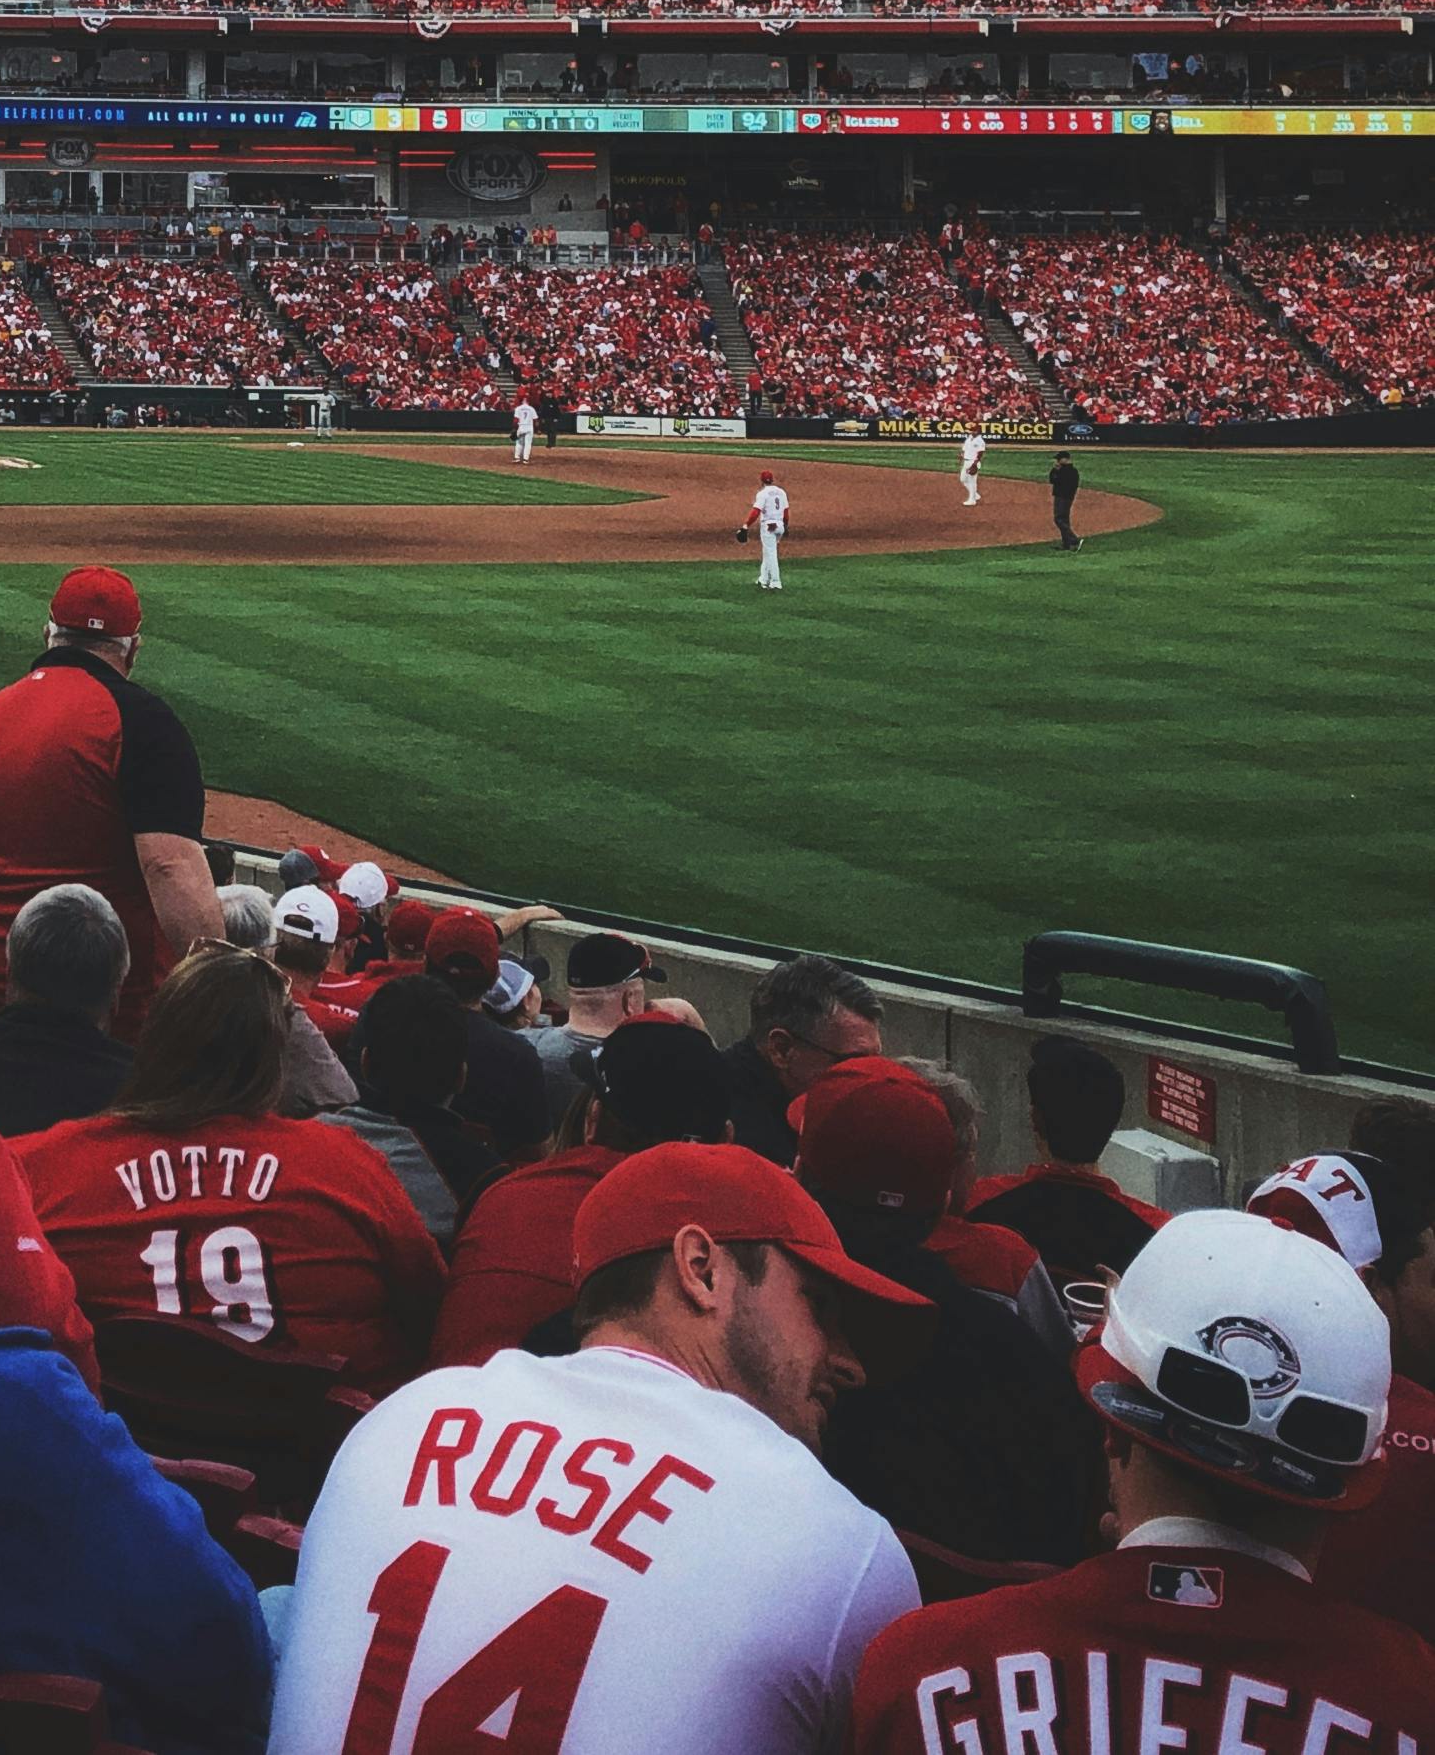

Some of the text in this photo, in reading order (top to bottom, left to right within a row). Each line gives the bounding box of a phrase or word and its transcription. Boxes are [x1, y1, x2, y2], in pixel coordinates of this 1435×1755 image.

[148, 111, 285, 124] ALL GRIT NO QUIT
[388, 109, 402, 128] 3
[432, 110, 448, 129] 5
[584, 118, 596, 130] 0
[742, 112, 768, 127] 94
[805, 115, 820, 124] 26
[845, 115, 900, 128] IGLESIAS
[941, 121, 950, 130] 0
[962, 121, 972, 130] 0
[979, 121, 1004, 130] 0.00
[1020, 121, 1028, 130] 3
[1069, 121, 1078, 130] 0
[55, 141, 85, 153] FOX
[467, 154, 527, 178] FOX
[468, 177, 527, 190] SPORTS
[879, 421, 1054, 435] MIKE CASTRUCCI
[774, 497, 780, 510] 9
[115, 1146, 279, 1211] VOTTO
[139, 1226, 275, 1343] 19
[403, 1408, 716, 1575] ROSE
[342, 1540, 609, 1755] 14
